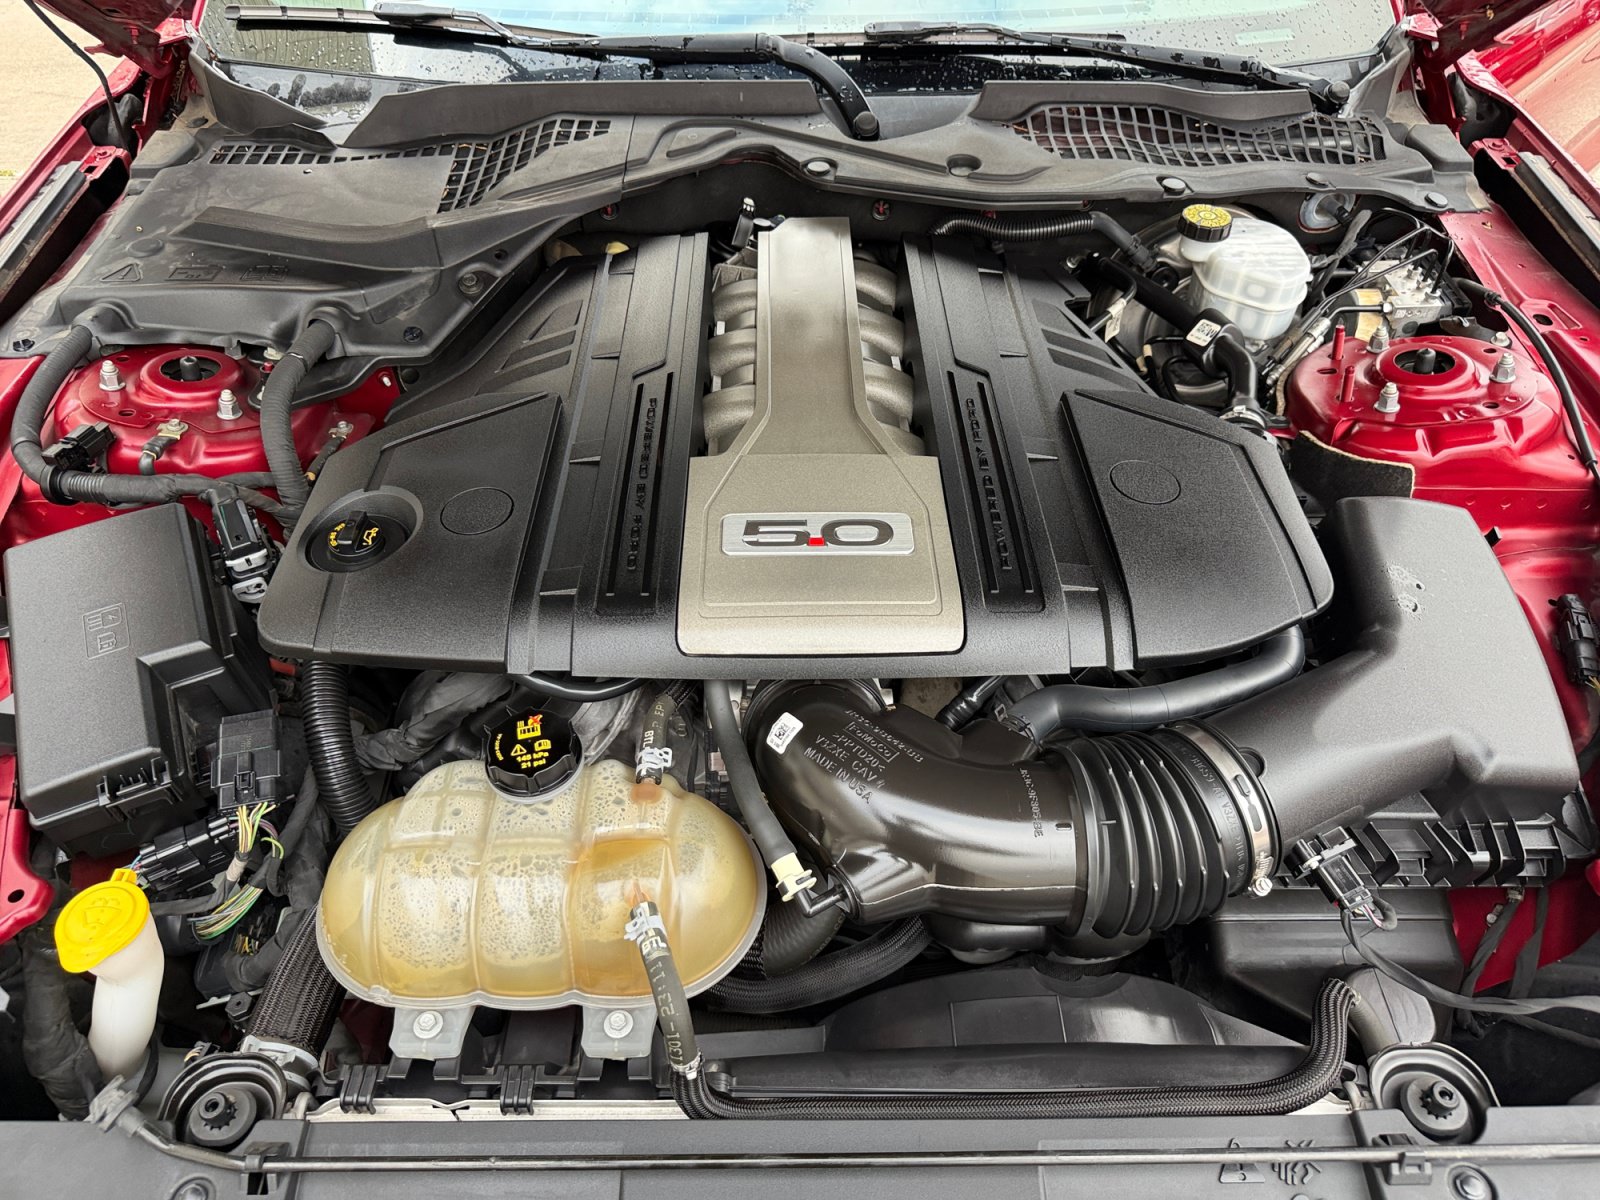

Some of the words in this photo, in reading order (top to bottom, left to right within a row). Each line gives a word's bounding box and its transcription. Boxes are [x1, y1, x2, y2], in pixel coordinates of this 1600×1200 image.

[638, 397, 657, 480] POWERED
[966, 397, 983, 443] FORD
[975, 446, 989, 471] BY
[635, 482, 646, 510] BY
[627, 514, 643, 572] FORD
[742, 518, 894, 547] 5.0
[815, 734, 850, 762] V3ZXE
[851, 760, 878, 782] CAV
[848, 724, 892, 757] FoMoCo
[521, 761, 531, 769] 21
[803, 747, 838, 773] MADE
[835, 767, 851, 782] IN
[848, 778, 872, 804] USA
